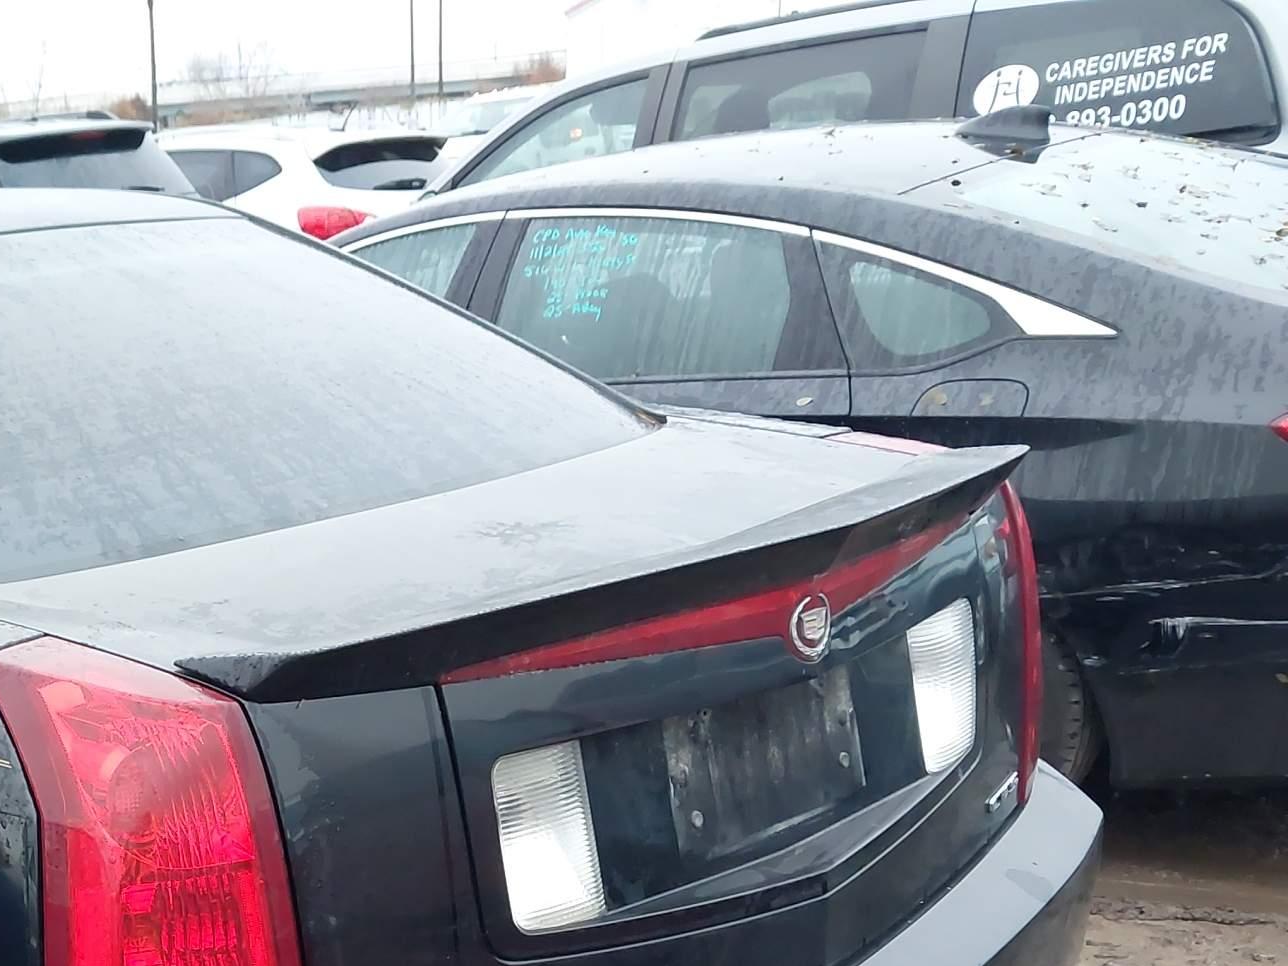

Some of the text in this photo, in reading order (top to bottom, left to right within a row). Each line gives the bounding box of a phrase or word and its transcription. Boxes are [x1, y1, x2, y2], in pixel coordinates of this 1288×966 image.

[1045, 32, 1229, 83] CAREGIVERS FOR
[1054, 60, 1215, 105] INDEPENDENCE
